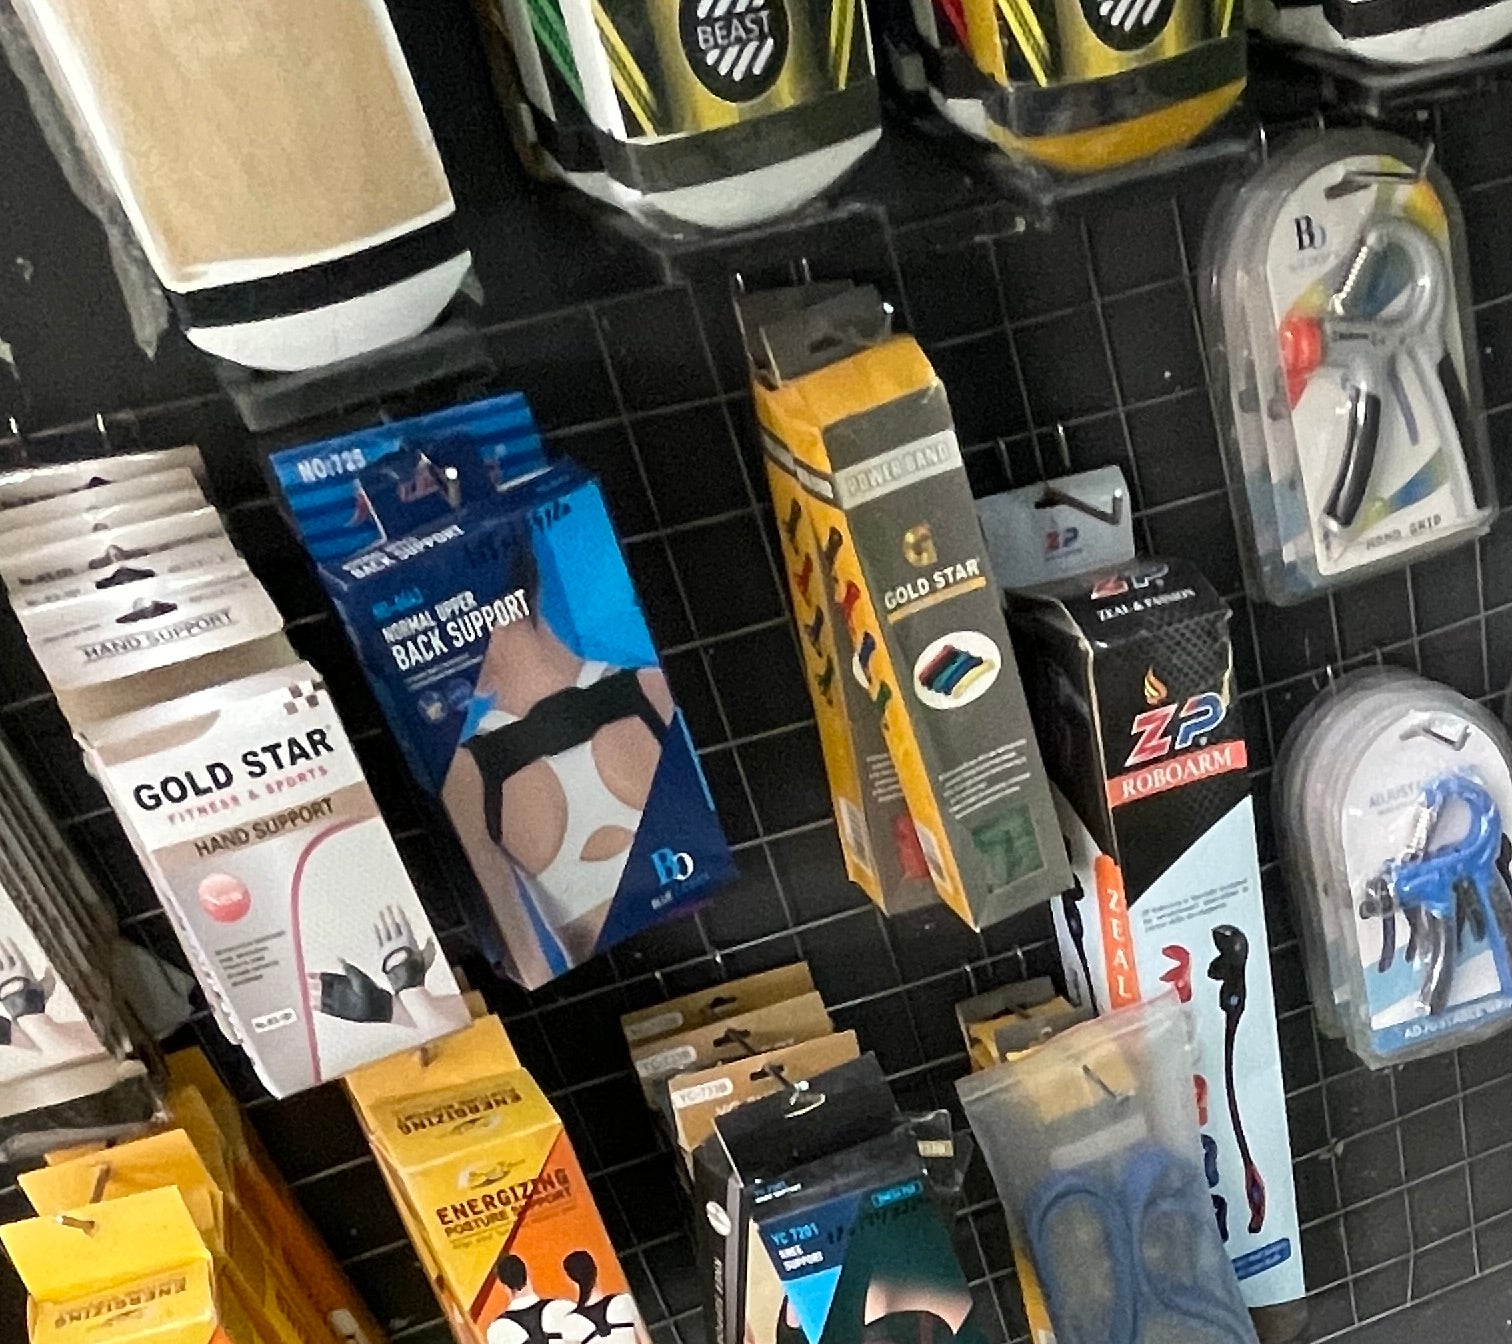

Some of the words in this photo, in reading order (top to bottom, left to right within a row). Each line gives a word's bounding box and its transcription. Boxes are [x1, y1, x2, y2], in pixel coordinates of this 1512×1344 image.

[697, 9, 772, 48] BEAST
[883, 578, 931, 611] GOLD
[932, 558, 981, 589] STAR
[82, 635, 143, 661] HAND
[149, 608, 233, 646] SUPPORT
[382, 610, 436, 645] NORMAL
[436, 590, 478, 623] UPPER
[391, 629, 448, 672] BACK
[447, 588, 532, 650] SUPPORT
[133, 760, 235, 812] GOLD
[241, 727, 335, 781] STAR
[166, 793, 242, 826] FITNESS
[265, 765, 330, 796] SPORTS
[1121, 745, 1233, 800] ROBOARM
[194, 826, 251, 859] HAND
[252, 797, 335, 841] SUPPORT
[436, 1167, 571, 1226] ENERGIZING
[444, 1209, 510, 1237] POSTURE
